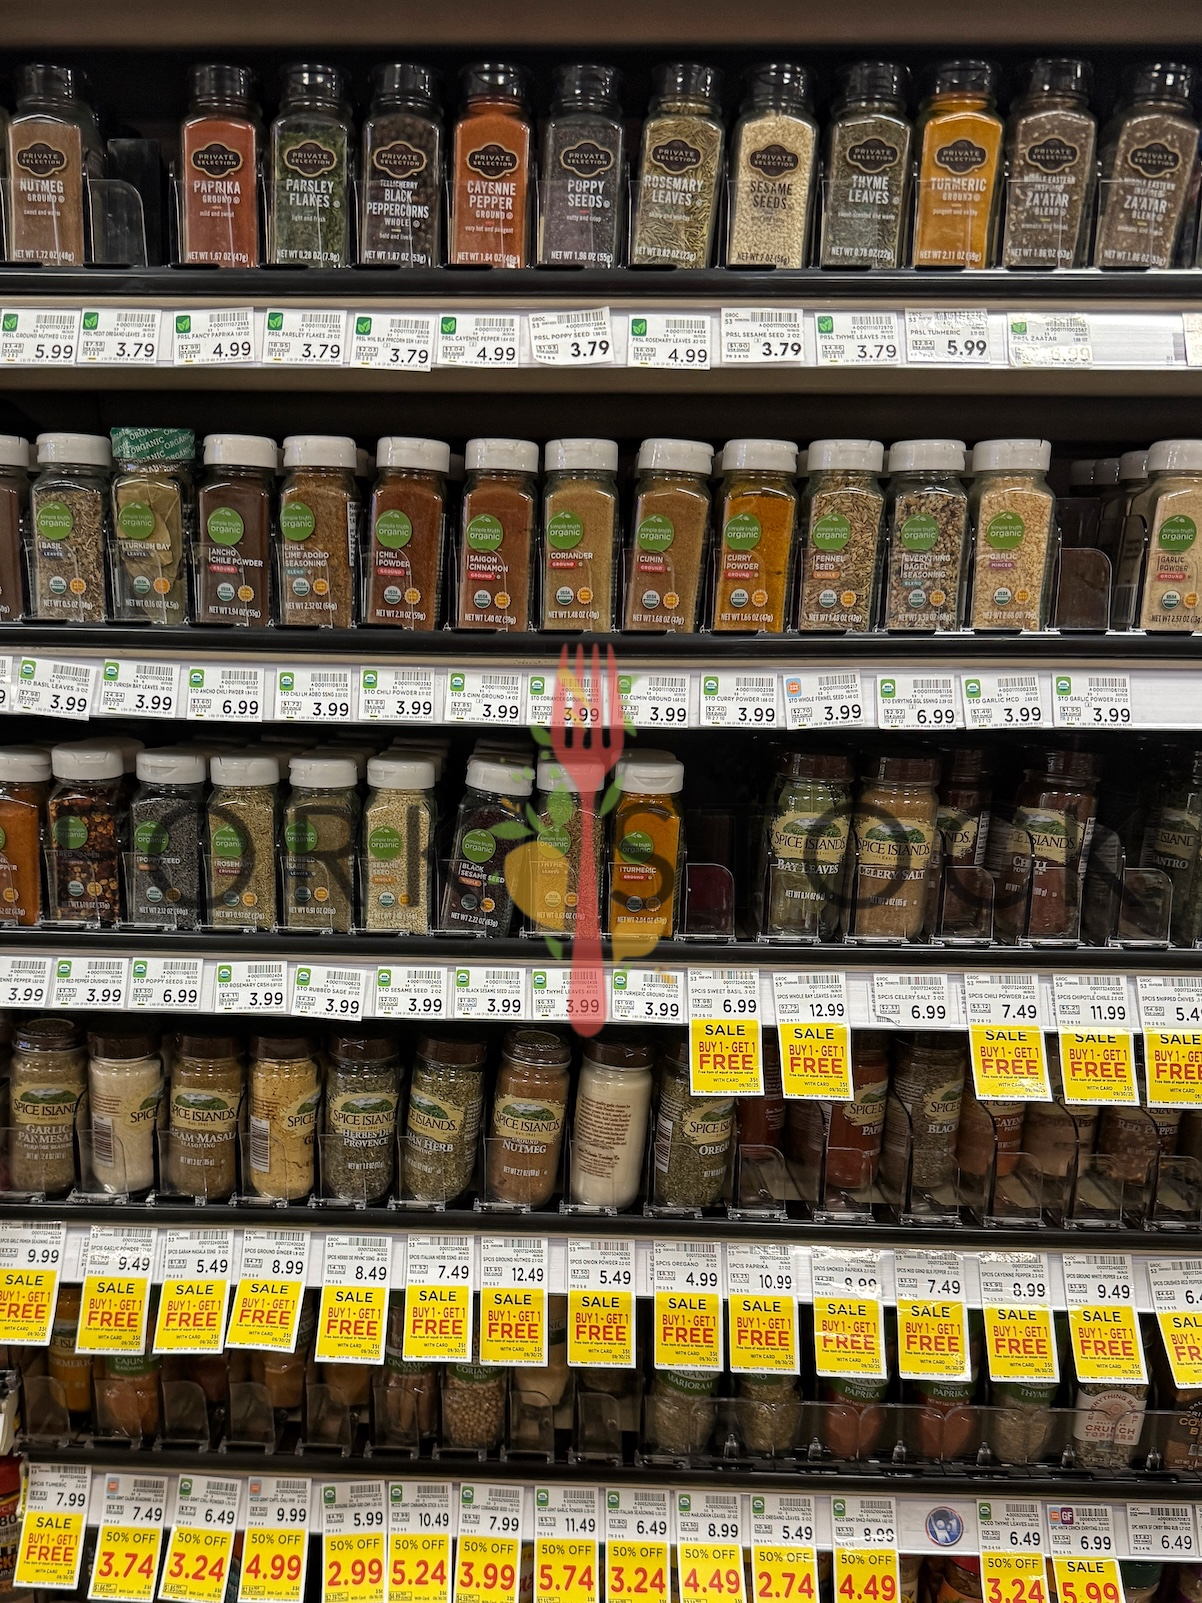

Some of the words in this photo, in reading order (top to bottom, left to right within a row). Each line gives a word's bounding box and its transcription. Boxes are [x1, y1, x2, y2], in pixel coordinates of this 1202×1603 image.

[20, 180, 63, 193] NUTMEG
[194, 181, 241, 194] PAPRIKA
[286, 179, 334, 194] PARSLEY
[467, 181, 516, 196] CAYENNE
[568, 180, 604, 194] POPPY
[644, 175, 703, 192] ROSEMARY
[750, 181, 792, 196] SESAME
[852, 176, 888, 191] THYME
[931, 177, 986, 191] TURMERIC
[289, 193, 329, 208] FLAKES
[384, 189, 413, 203] BLACK
[469, 195, 512, 210] PEPPER
[568, 194, 602, 208] SEEDS
[652, 191, 691, 206] LEAVES
[753, 195, 787, 209] SEEDS
[848, 190, 889, 204] LEAVES
[1026, 192, 1069, 208] ZA'ATAR
[366, 202, 430, 220] PEPPERCORNS
[1124, 197, 1167, 213] ZA'ATAR
[35, 344, 73, 359] 5.99
[116, 342, 154, 357] 3.79
[213, 342, 251, 358] 4.99
[302, 344, 340, 359] 3.79
[477, 347, 515, 361] 4.99
[571, 341, 609, 357] 3.79
[762, 342, 801, 357] 3.79
[858, 344, 896, 358] 3.79
[947, 340, 986, 356] 5.99
[390, 348, 429, 364] 3.79
[668, 349, 707, 362] 4.99
[40, 519, 70, 528] organic
[470, 533, 500, 541] organic
[550, 529, 580, 537] organic
[991, 530, 1022, 538] organic
[212, 549, 236, 557] ANCHO
[469, 555, 497, 563] SAIGON
[551, 552, 593, 560] CORIANDER
[727, 554, 752, 562] CURRY
[816, 555, 845, 563] FENNEL
[905, 554, 951, 562] EVERYTHING
[232, 558, 263, 567] POWDER
[379, 559, 410, 567] POWDER
[469, 563, 508, 572] CINNAMON
[726, 562, 759, 571] POWDER
[51, 694, 87, 712] 3.99
[136, 694, 172, 710] 3.99
[222, 700, 258, 714] 6.99
[313, 702, 348, 716] 3.99
[396, 700, 432, 714] 3.99
[483, 704, 518, 718] 3.99
[564, 707, 599, 722] 3.99
[650, 707, 686, 722] 3.99
[738, 707, 774, 721] 3.99
[824, 704, 861, 720] 3.99
[917, 709, 954, 724] 6.99
[1004, 707, 1041, 721] 3.99
[1093, 708, 1130, 722] 3.99
[775, 836, 803, 849] SPICE
[804, 837, 845, 850] ISLANDS
[462, 863, 484, 872] BLACK
[778, 859, 796, 873] BAY
[798, 862, 838, 874] LEAVES
[461, 871, 487, 880] SESAME
[8, 988, 43, 1001] 3.99
[88, 988, 121, 1002] 3.99
[163, 990, 197, 1002] 6.99
[250, 992, 283, 1005] 3.99
[326, 999, 359, 1014] 3.99
[408, 998, 442, 1012] 3.99
[488, 998, 521, 1012] 3.99
[566, 999, 599, 1012] 3.99
[646, 1002, 679, 1016] 3.99
[723, 1000, 756, 1012] 6.99
[810, 1003, 844, 1016] 12.99
[911, 1005, 946, 1019] 6.99
[1002, 1005, 1037, 1018] 7.49
[1091, 1006, 1126, 1020] 11.99
[705, 1024, 745, 1036] SALE
[794, 1028, 834, 1040] SALE
[700, 1042, 716, 1053] BUY
[719, 1042, 722, 1052] 1
[732, 1042, 748, 1053] GET
[752, 1042, 755, 1053] 1
[700, 1054, 753, 1070] FREE
[790, 1058, 842, 1074] FREE
[982, 1059, 1038, 1075] FREE
[495, 1114, 517, 1127] SPICE
[519, 1116, 559, 1130] ISLANDS
[344, 1138, 388, 1146] PROVENCE
[502, 1143, 546, 1154] NUTMEG
[28, 1248, 59, 1263] 9.99
[118, 1257, 150, 1271] 9.49
[196, 1259, 227, 1273] 5.49
[272, 1260, 304, 1274] 8.99
[356, 1266, 387, 1281] 8.49
[438, 1265, 469, 1279] 7.49
[512, 1267, 544, 1282] 12.49
[600, 1270, 631, 1285] 5.49
[686, 1272, 717, 1287] 4.99
[759, 1273, 792, 1289] 10.99
[928, 1279, 960, 1294] 7.49
[335, 1291, 373, 1303] SALE
[1098, 1285, 1130, 1299] 9.49
[911, 1306, 950, 1317] SALE
[326, 1321, 377, 1336] FREE
[906, 1335, 958, 1352] FREE
[933, 1387, 968, 1396] PAPRIKA
[1021, 1389, 1049, 1398] THYME
[133, 1507, 162, 1522] 7.49
[205, 1510, 234, 1525] 6.49
[277, 1508, 306, 1523] 9.99
[106, 1532, 129, 1544] 50%
[132, 1533, 155, 1545] OFF
[1010, 1531, 1040, 1547] 6.49
[1081, 1536, 1111, 1550] 6.99
[98, 1552, 154, 1579] 3.74
[169, 1552, 224, 1582] 3.24
[246, 1553, 301, 1580] 4.99
[328, 1558, 383, 1586] 2.99
[1067, 1561, 1104, 1573] SALE
[391, 1560, 447, 1586] 5.24
[460, 1562, 515, 1590] 3.99
[539, 1564, 594, 1591] 5.74
[611, 1566, 665, 1594] 3.24
[684, 1567, 740, 1594] 4.49
[758, 1571, 813, 1599] 2.74
